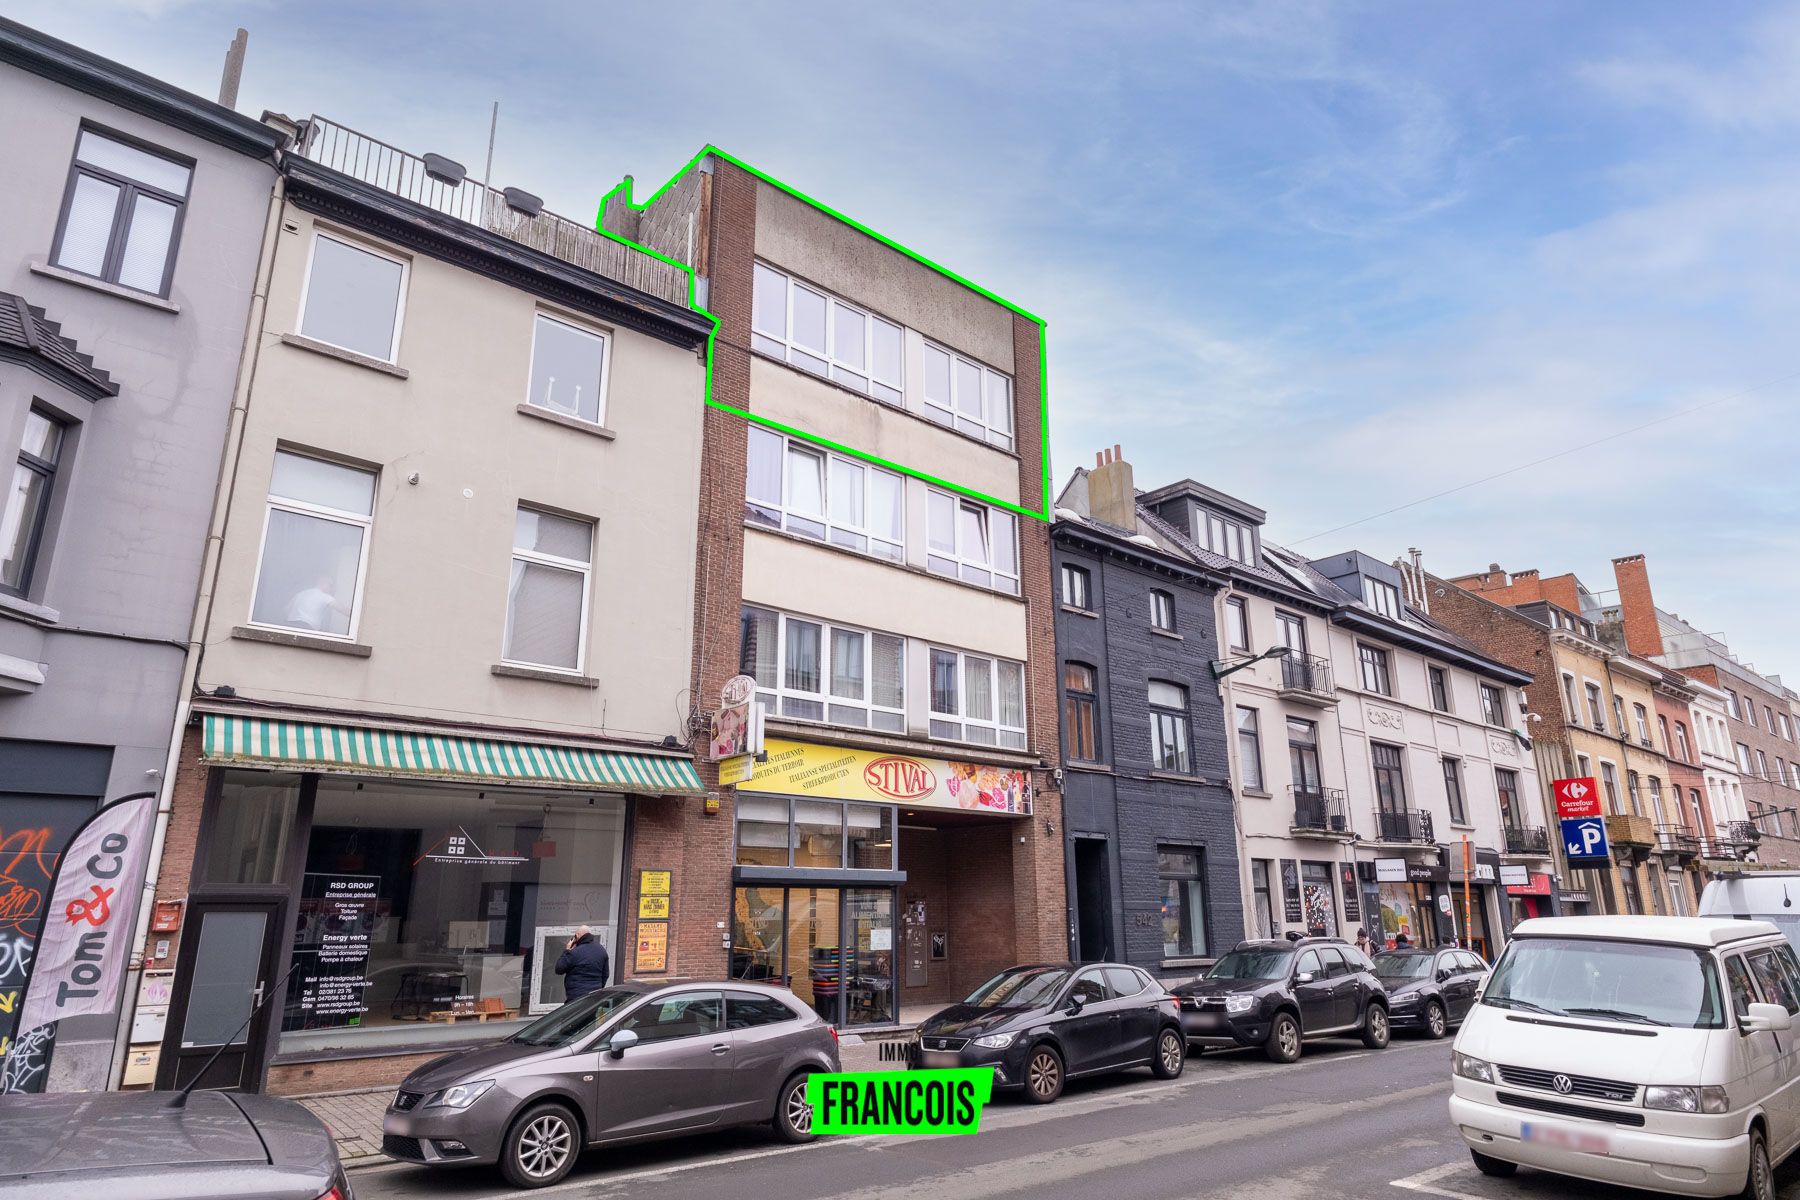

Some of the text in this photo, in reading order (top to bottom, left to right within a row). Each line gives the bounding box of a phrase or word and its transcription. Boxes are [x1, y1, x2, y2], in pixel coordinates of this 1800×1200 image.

[802, 769, 850, 790] STREEKPRODUCTEN
[867, 757, 933, 794] STIVAL
[1582, 828, 1601, 854] P
[56, 833, 128, 1007] Tom & Co
[323, 934, 348, 942] Energy
